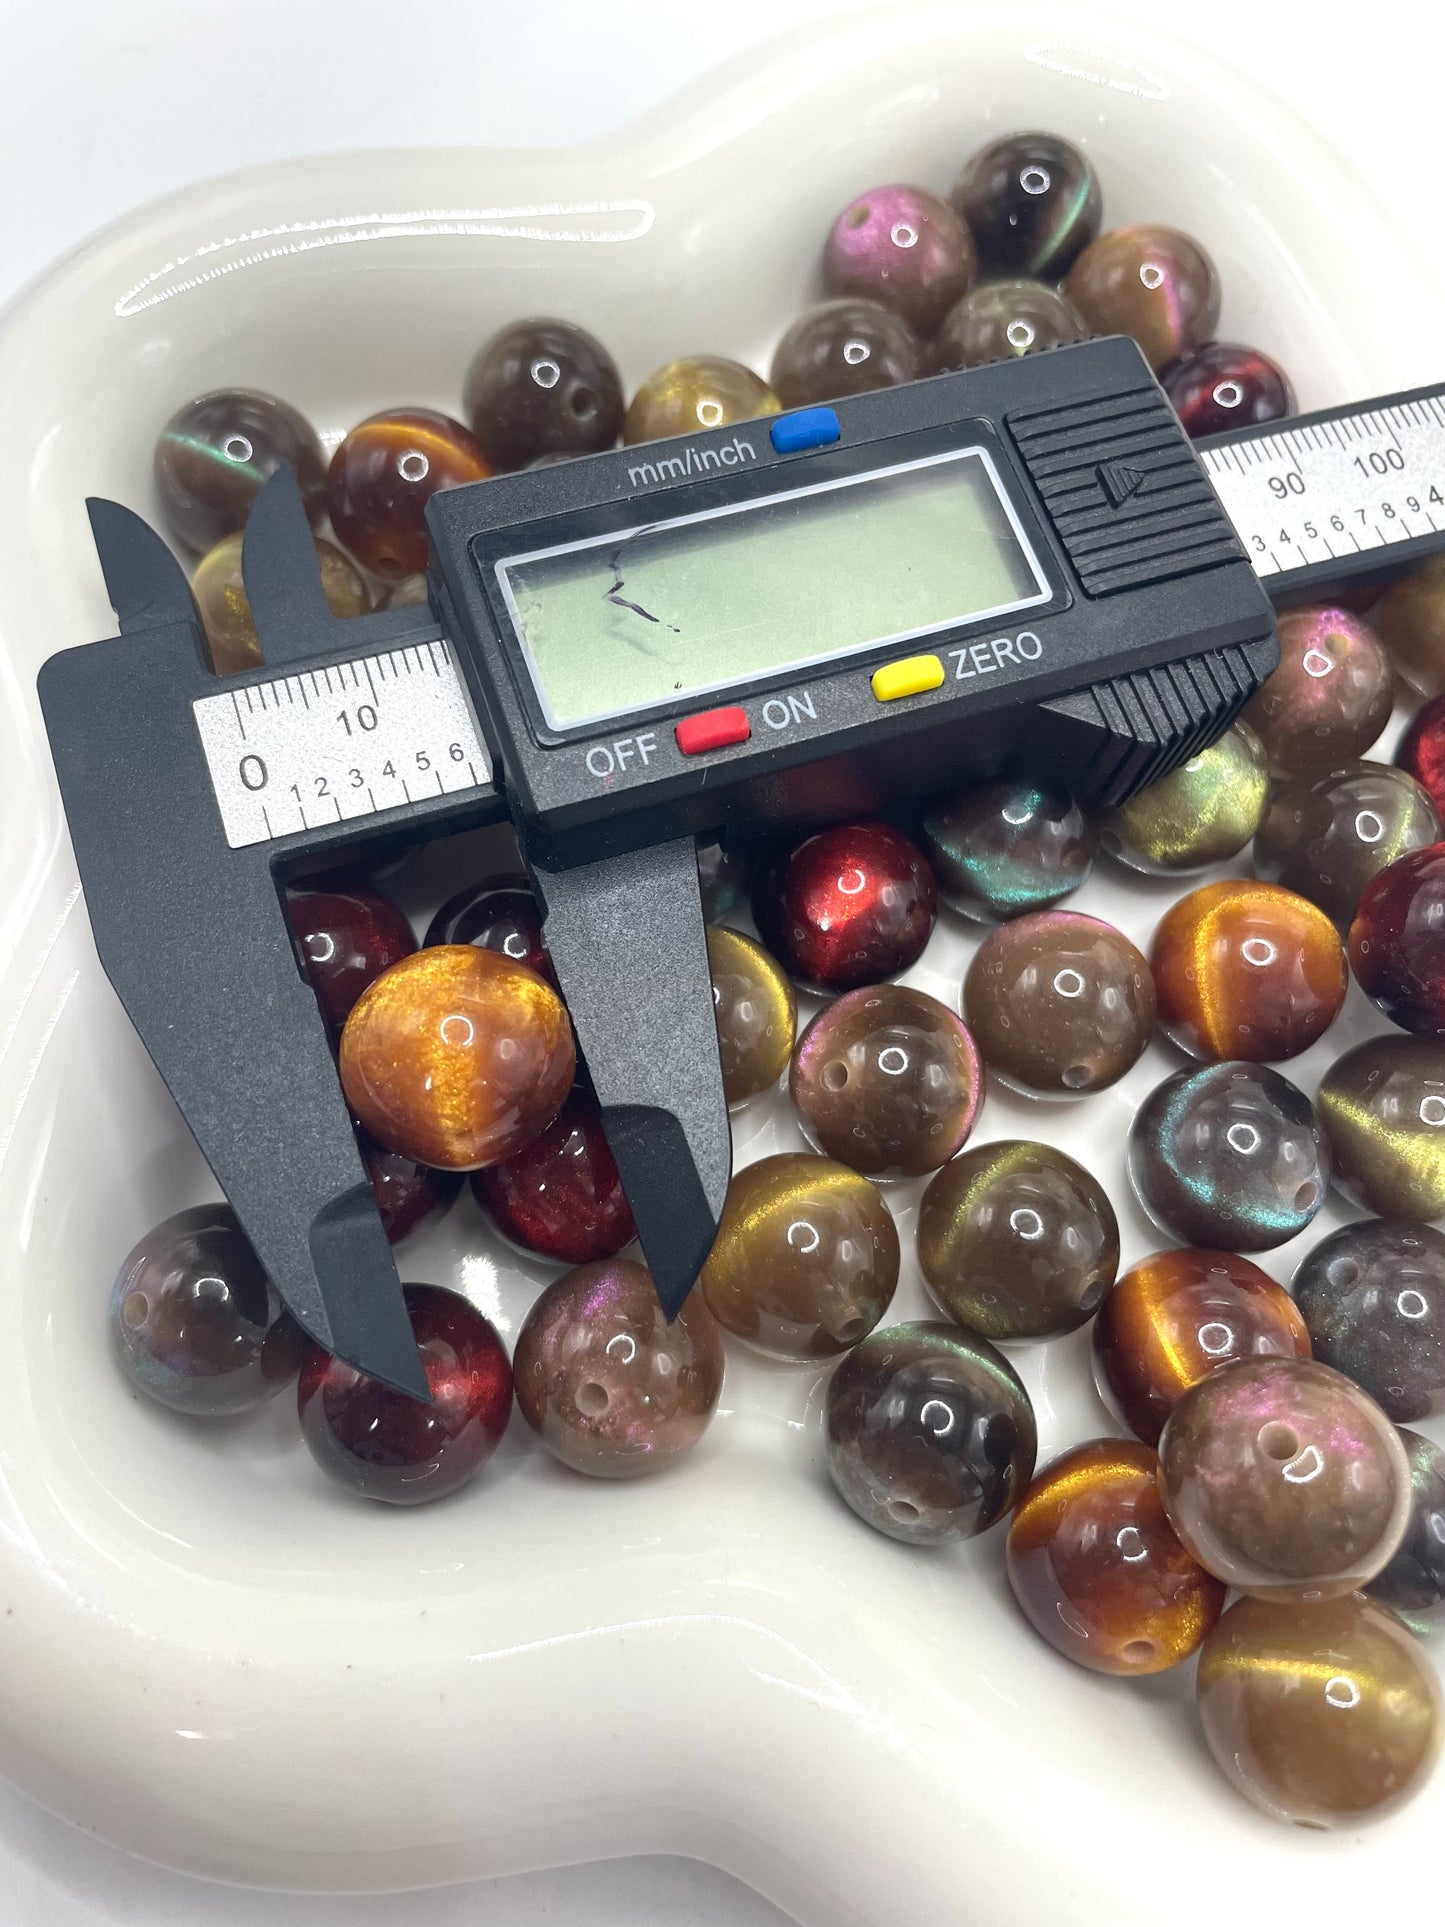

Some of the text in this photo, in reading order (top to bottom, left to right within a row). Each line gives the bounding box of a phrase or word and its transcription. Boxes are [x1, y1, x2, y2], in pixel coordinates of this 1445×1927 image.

[628, 438, 756, 487] mm/inch
[1268, 449, 1405, 499] 90 100
[1251, 485, 1445, 552] 3 4 5 6 7 8 9 4
[948, 631, 1043, 680] ZERO
[762, 691, 818, 730] ON
[238, 705, 379, 791] 0 10
[290, 743, 465, 802] 1 2 3 4 5 6
[585, 733, 658, 778] OFF
